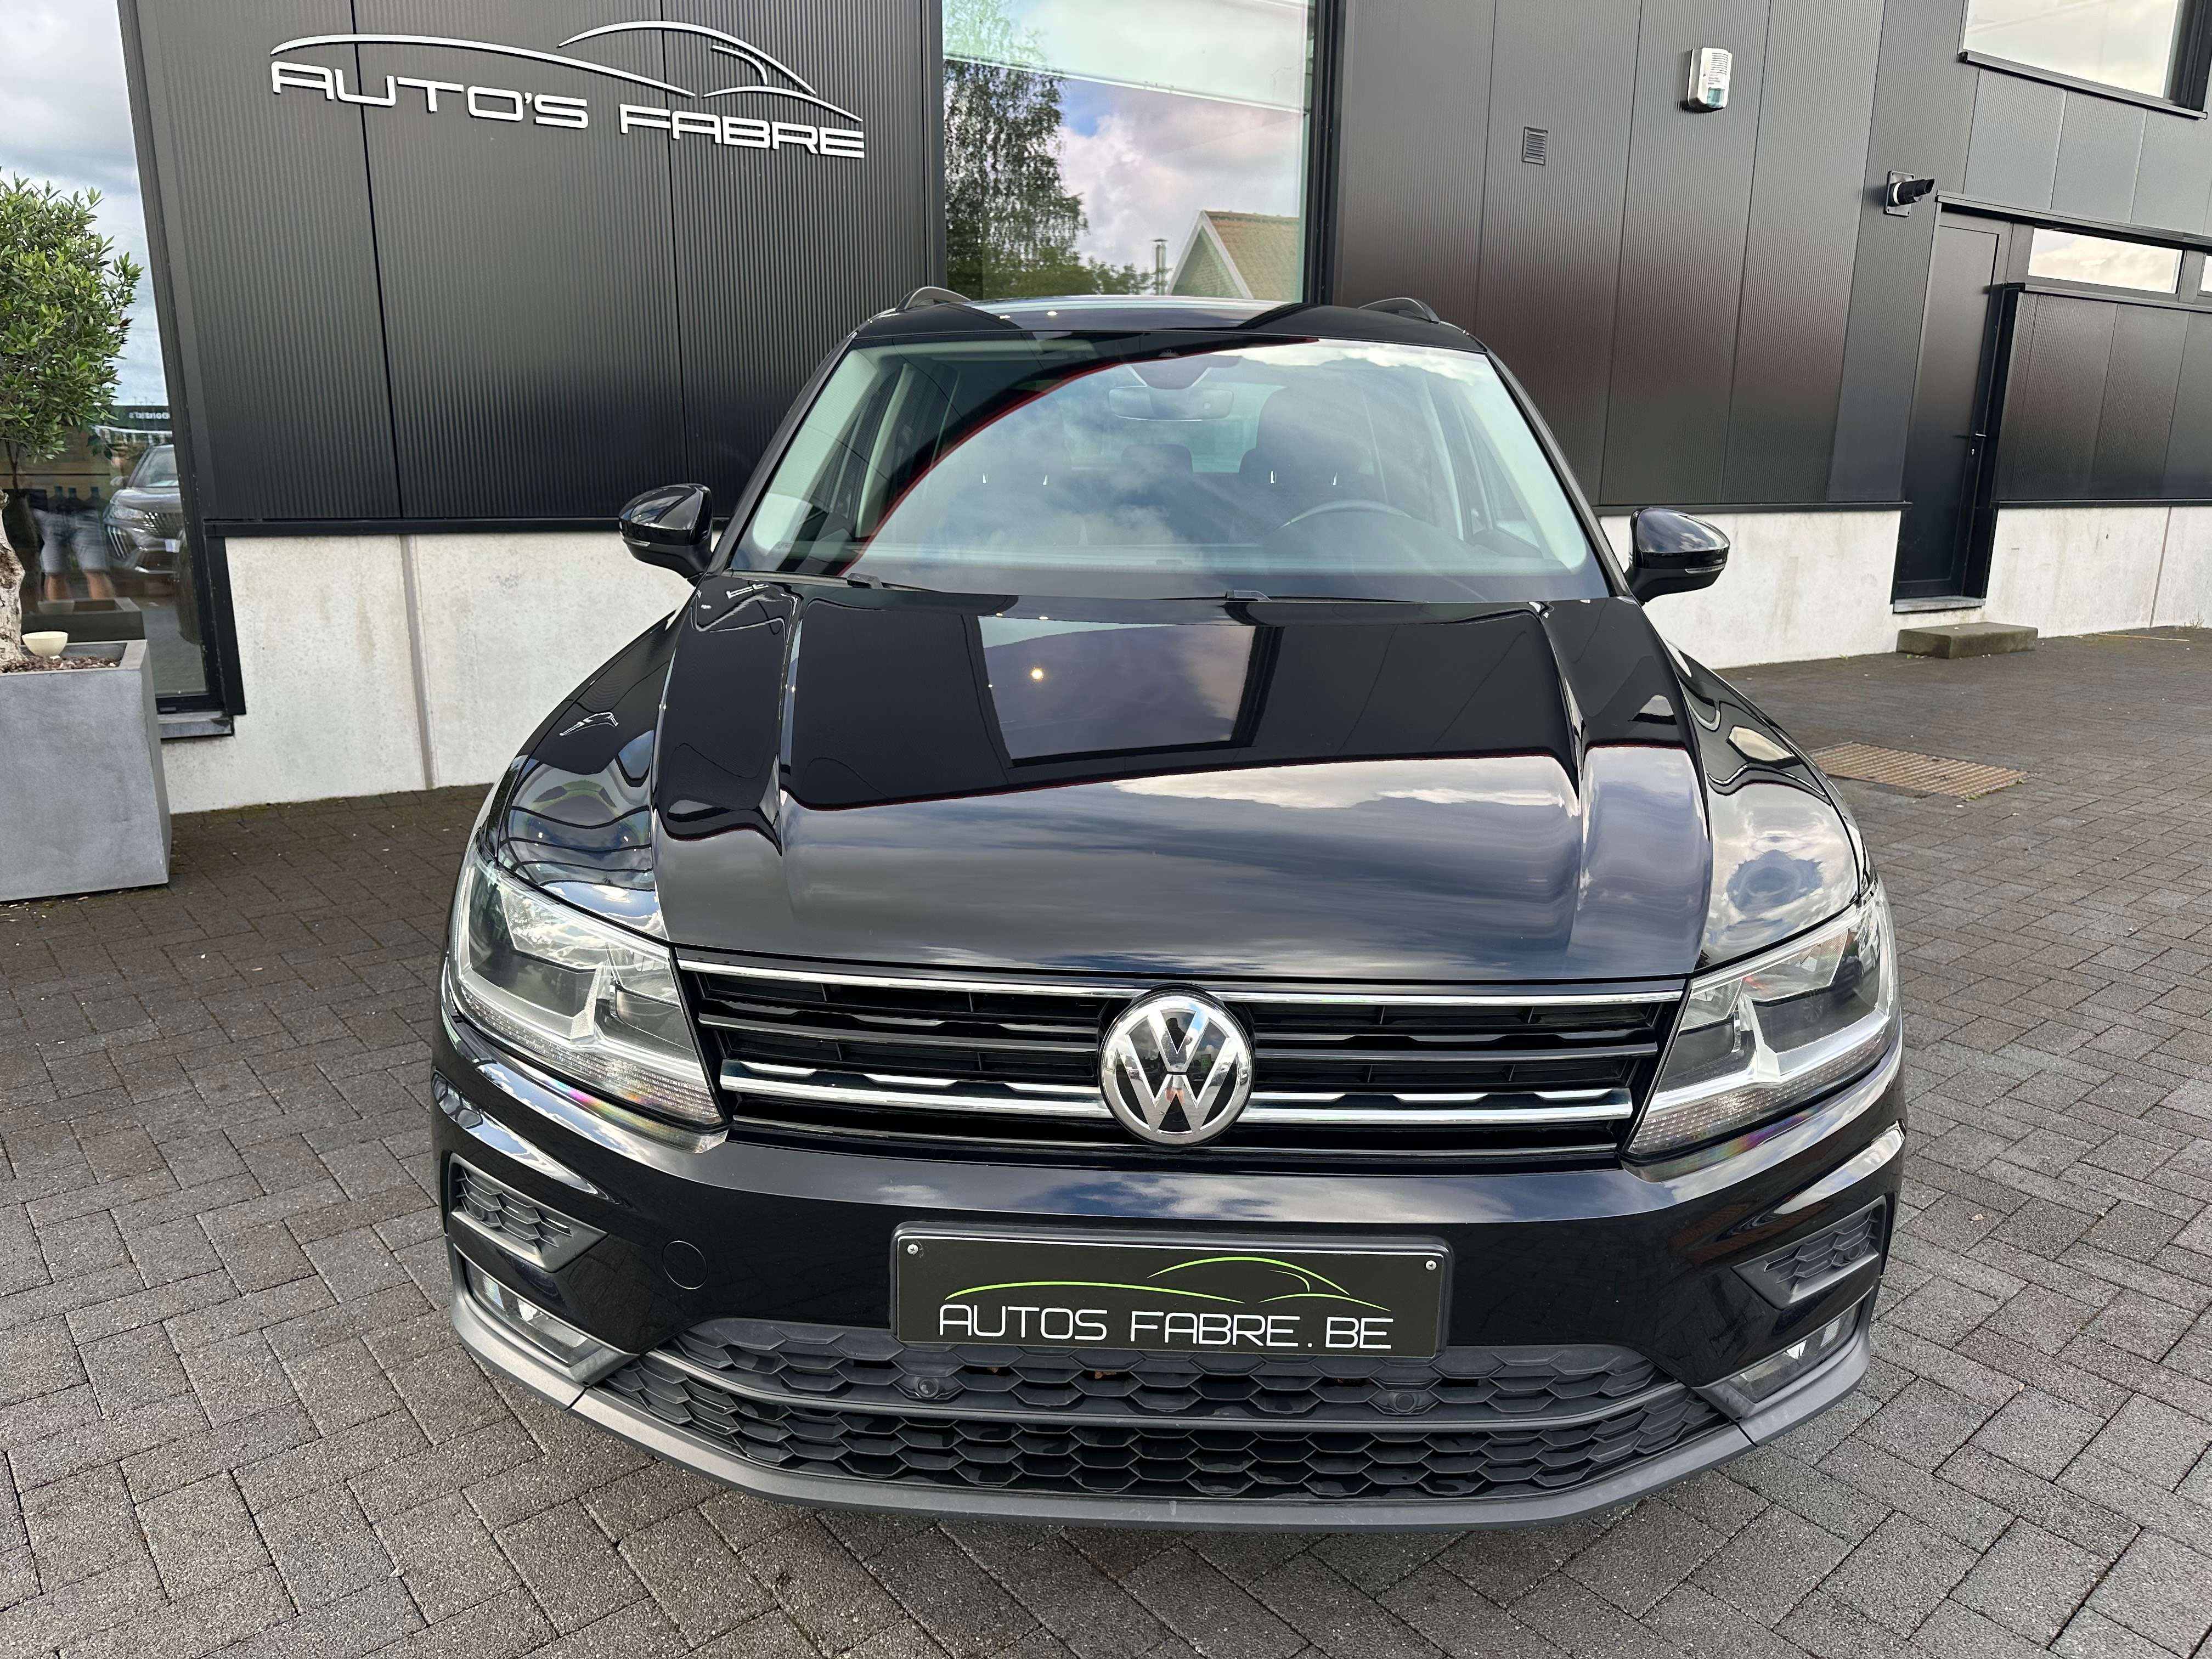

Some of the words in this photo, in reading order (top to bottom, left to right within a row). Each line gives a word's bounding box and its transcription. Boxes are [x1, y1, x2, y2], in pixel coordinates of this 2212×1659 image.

[271, 60, 589, 129] AUTO'S
[619, 103, 865, 159] FABRE
[939, 1304, 1108, 1341] AUTOS
